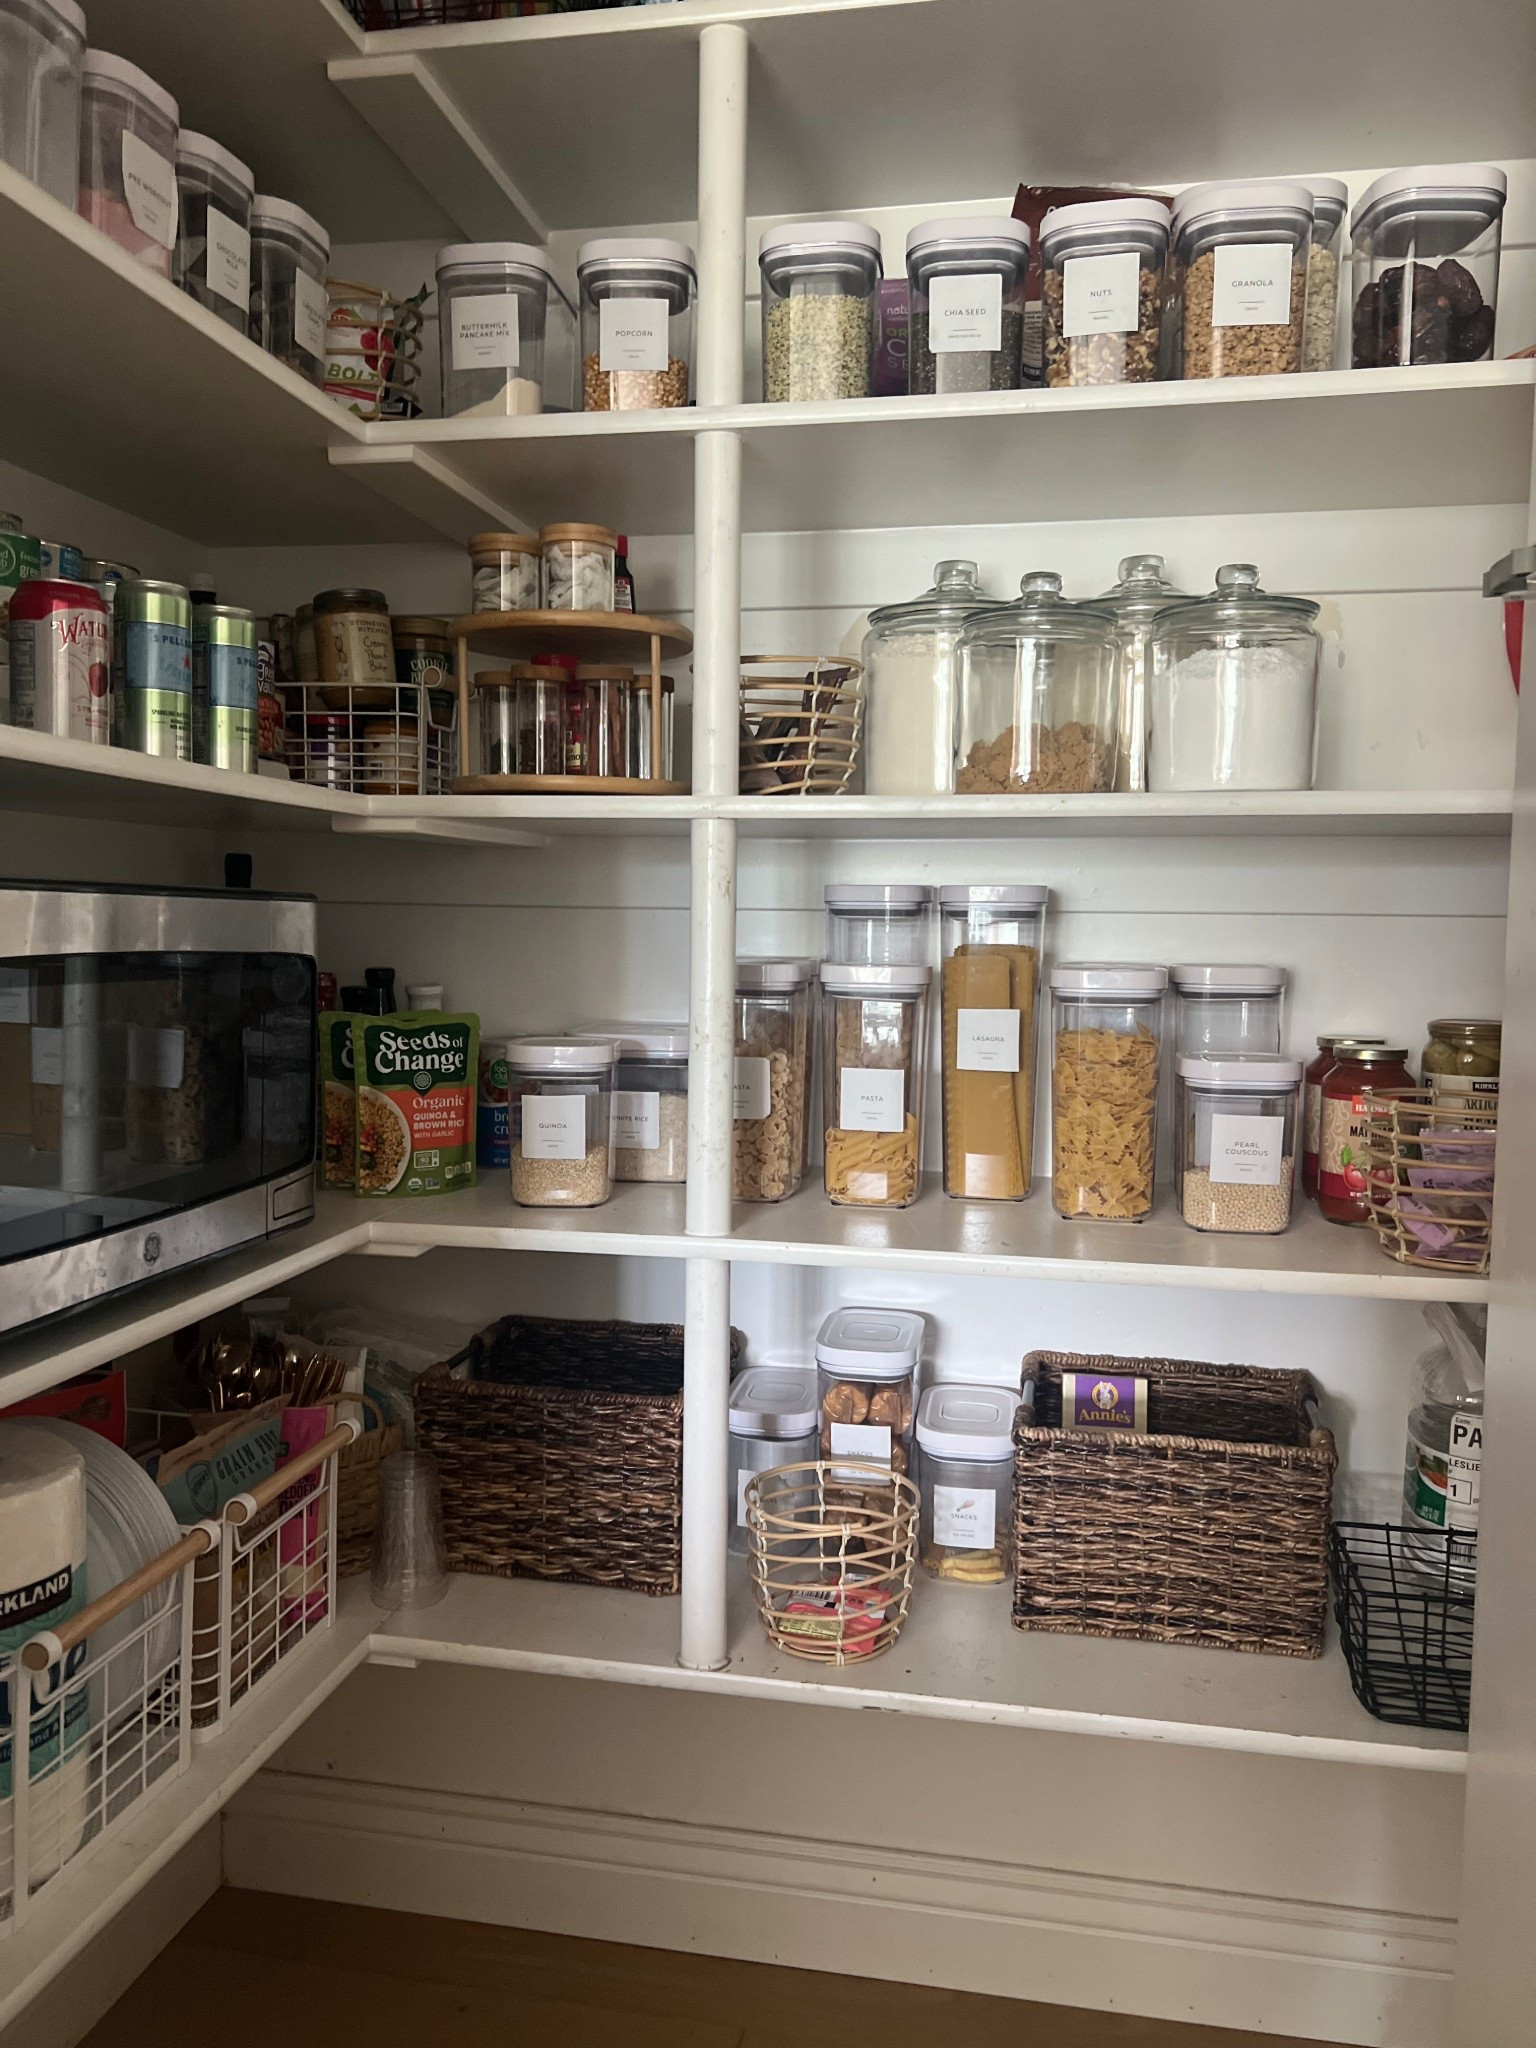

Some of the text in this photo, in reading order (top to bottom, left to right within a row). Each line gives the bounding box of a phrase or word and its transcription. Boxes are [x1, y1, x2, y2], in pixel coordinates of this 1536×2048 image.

[1231, 279, 1274, 288] GRANOLA
[1090, 289, 1112, 298] NUTS
[944, 308, 986, 317] CHIA SEED
[461, 321, 508, 331] BUTTERMILK
[460, 329, 510, 339] PANCAKE MIX
[615, 330, 653, 338] POPCORN
[379, 1030, 463, 1053] Seeds of
[374, 1050, 464, 1074] Change
[412, 1094, 465, 1110] Organic
[413, 1110, 456, 1121] QUINOA &
[413, 1120, 447, 1130] BROWN
[413, 1130, 455, 1139] WITH GARLIC
[1234, 1141, 1260, 1149] PEARL
[1225, 1148, 1269, 1157] COUSCOUS
[1079, 1408, 1131, 1424] Annie's
[215, 1442, 256, 1481] GRAIN
[1449, 1457, 1481, 1472] LESLIE
[1450, 1484, 1457, 1497] 1
[950, 1513, 977, 1521] SNACKS
